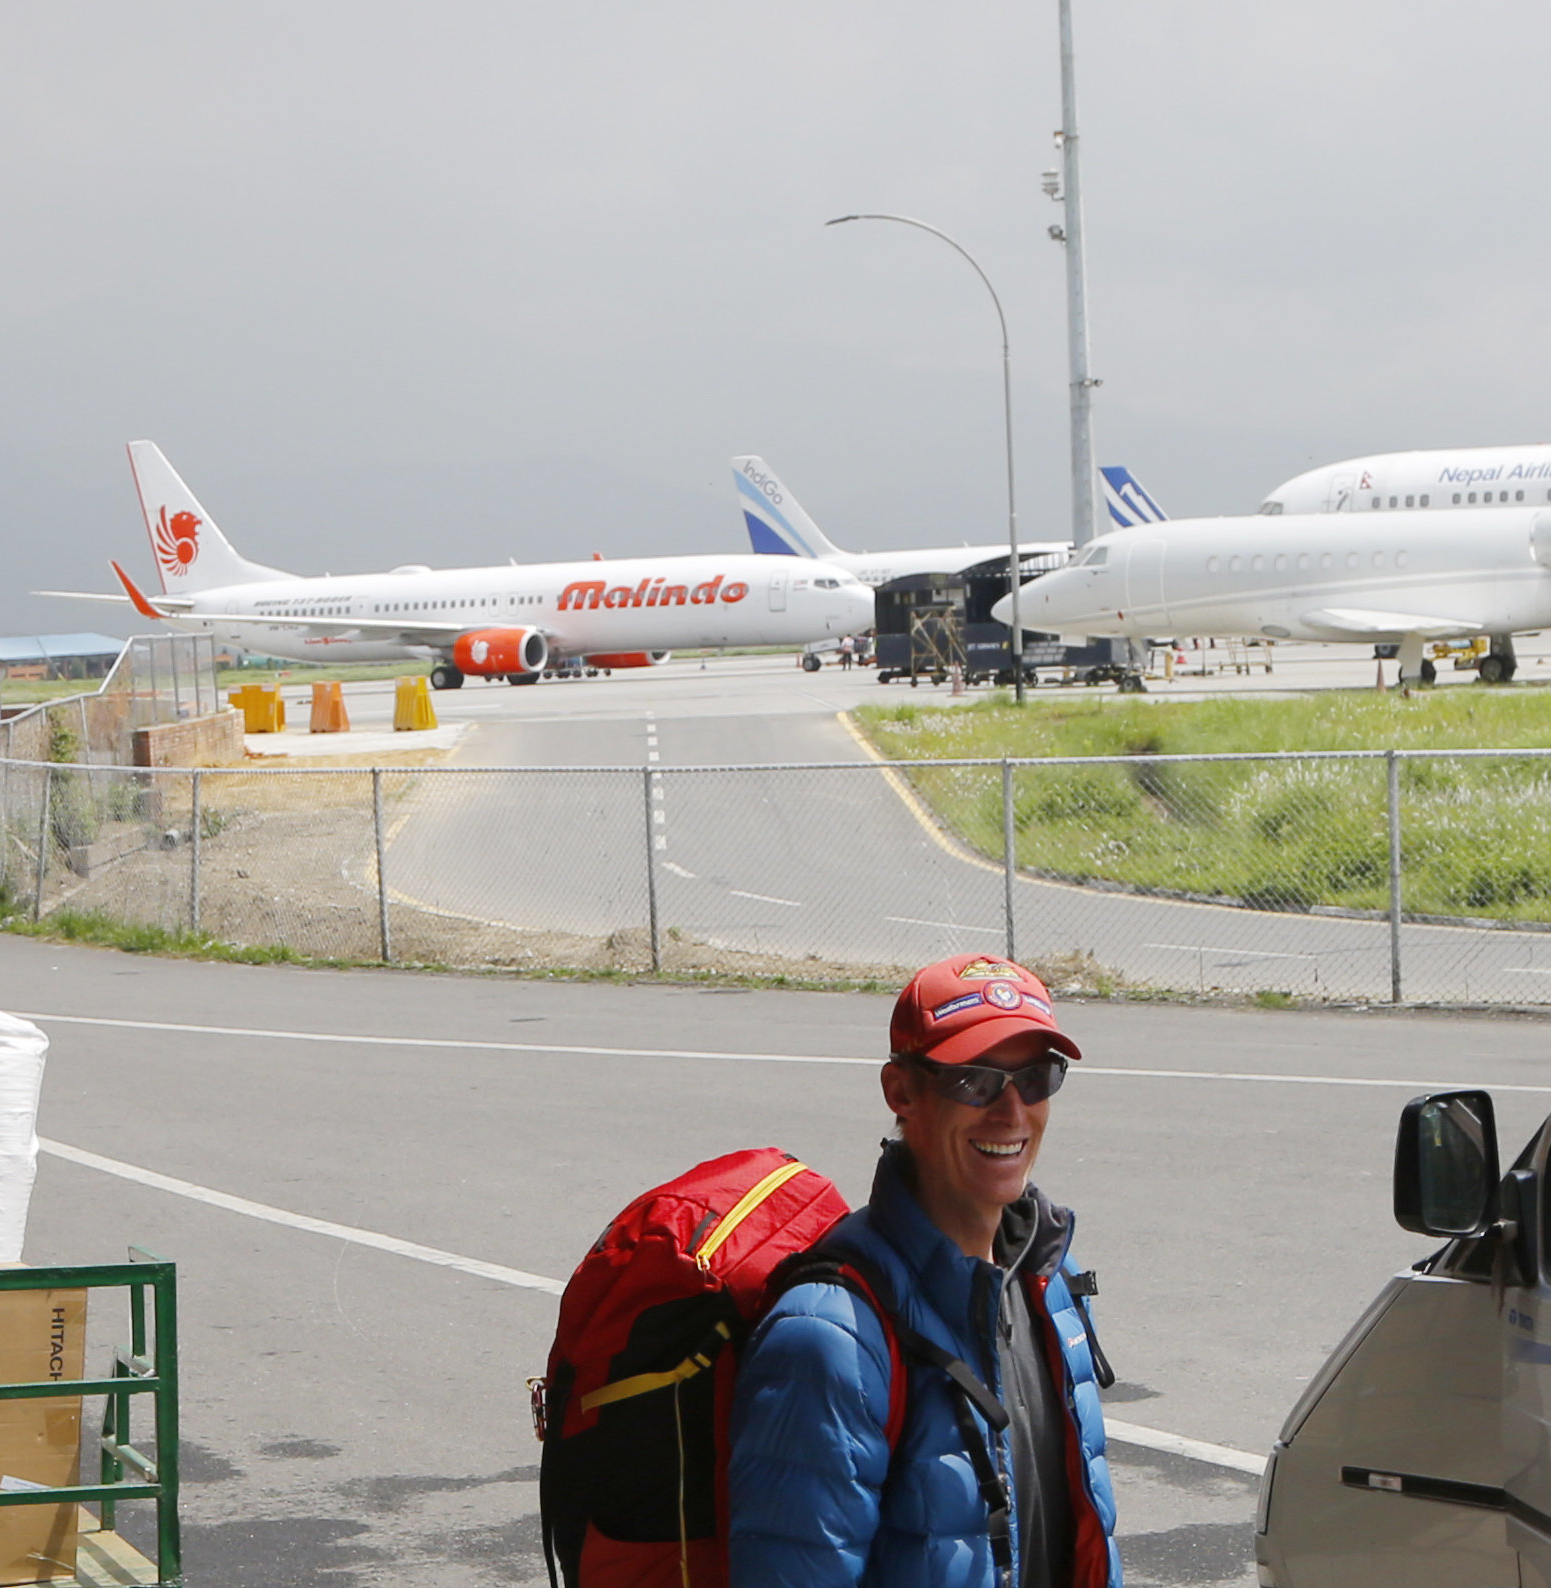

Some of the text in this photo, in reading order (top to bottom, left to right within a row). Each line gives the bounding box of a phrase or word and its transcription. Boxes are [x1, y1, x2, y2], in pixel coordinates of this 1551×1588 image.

[743, 459, 783, 504] IndiGo
[1438, 465, 1504, 487] Nepal
[557, 574, 749, 611] Malindo
[49, 1308, 65, 1381] HITACH
